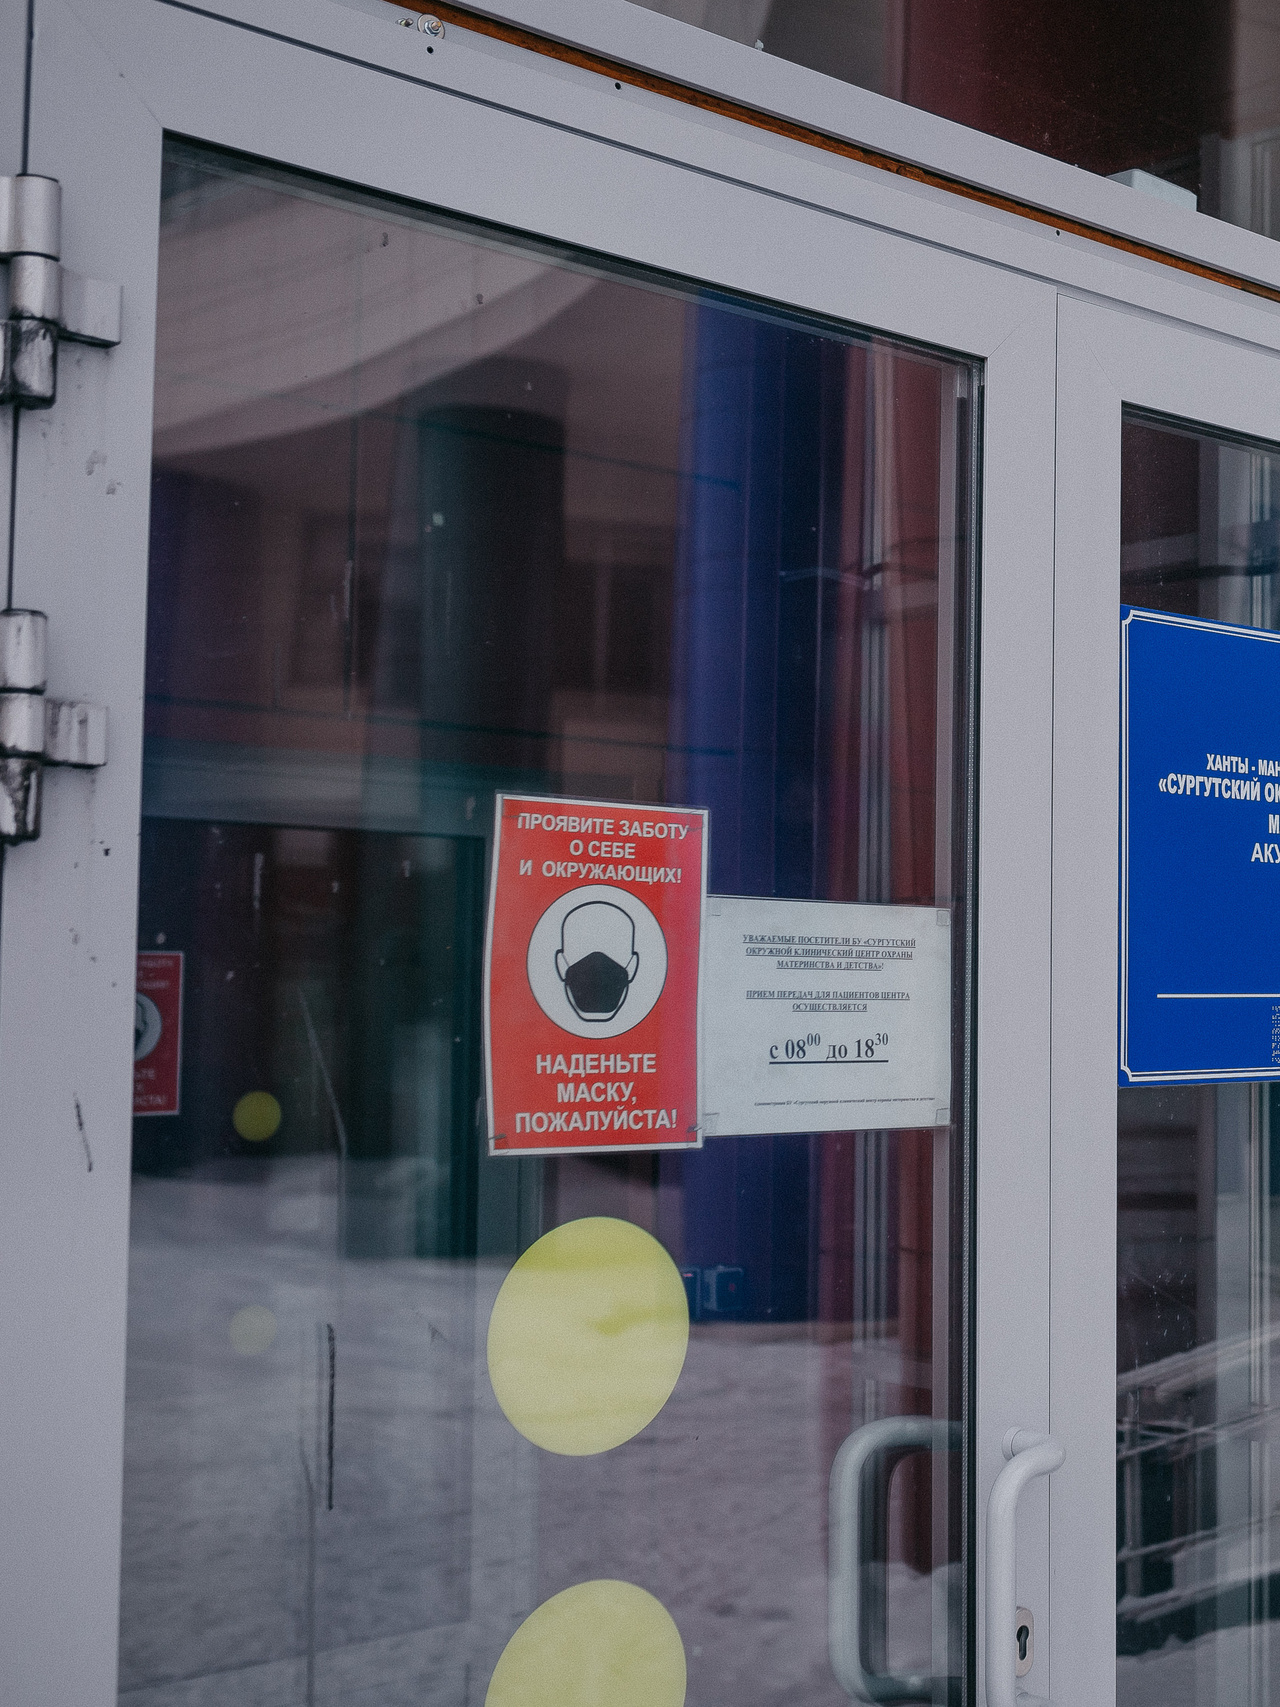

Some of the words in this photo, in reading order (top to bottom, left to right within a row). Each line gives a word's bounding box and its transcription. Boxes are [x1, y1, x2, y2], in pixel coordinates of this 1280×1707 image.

[1206, 753, 1248, 773] ХАНТЫ
[1158, 772, 1260, 801] «СУРГУТСКИЙ
[517, 812, 614, 834] ПРОЯВИТЕ
[618, 819, 689, 839] ЗАБОТУ
[569, 839, 583, 855] О
[587, 840, 635, 858] СЕБЕ
[519, 859, 532, 875] И
[541, 860, 681, 885] ОКРУЖАЮЩИХ!
[743, 934, 798, 944] УВАЖАЕМЫЕ
[798, 936, 851, 945] ПОСЕТИТЕЛИ
[851, 938, 862, 946] БУ
[863, 938, 917, 947] «СУРГУТСКИЙ
[745, 946, 792, 956] ОКРУЖНОЙ
[794, 947, 853, 958] КЛИНИЧЕСКИЙ
[855, 950, 880, 958] ЦЕНТР
[881, 950, 914, 958] ОХРАНЫ
[776, 960, 835, 969] МАТЕРИНСТВА
[836, 961, 842, 969] И
[746, 990, 775, 998] ПРИЕМ
[776, 990, 813, 999] ПЕРЕДАЧ
[814, 991, 831, 999] ДЛЯ
[832, 991, 880, 1000] ПАЦИЕНТОВ
[881, 992, 910, 1000] ЦЕНТРА
[792, 1003, 868, 1012] ОСУЩЕСТВЛЯЕТСЯ
[769, 1045, 779, 1059] с
[826, 1044, 848, 1062] до
[536, 1053, 656, 1077] НАДЕНЬТЕ
[557, 1082, 637, 1104] МАСКУ,
[515, 1106, 676, 1133] ПОЖАЛУЙСТА!
